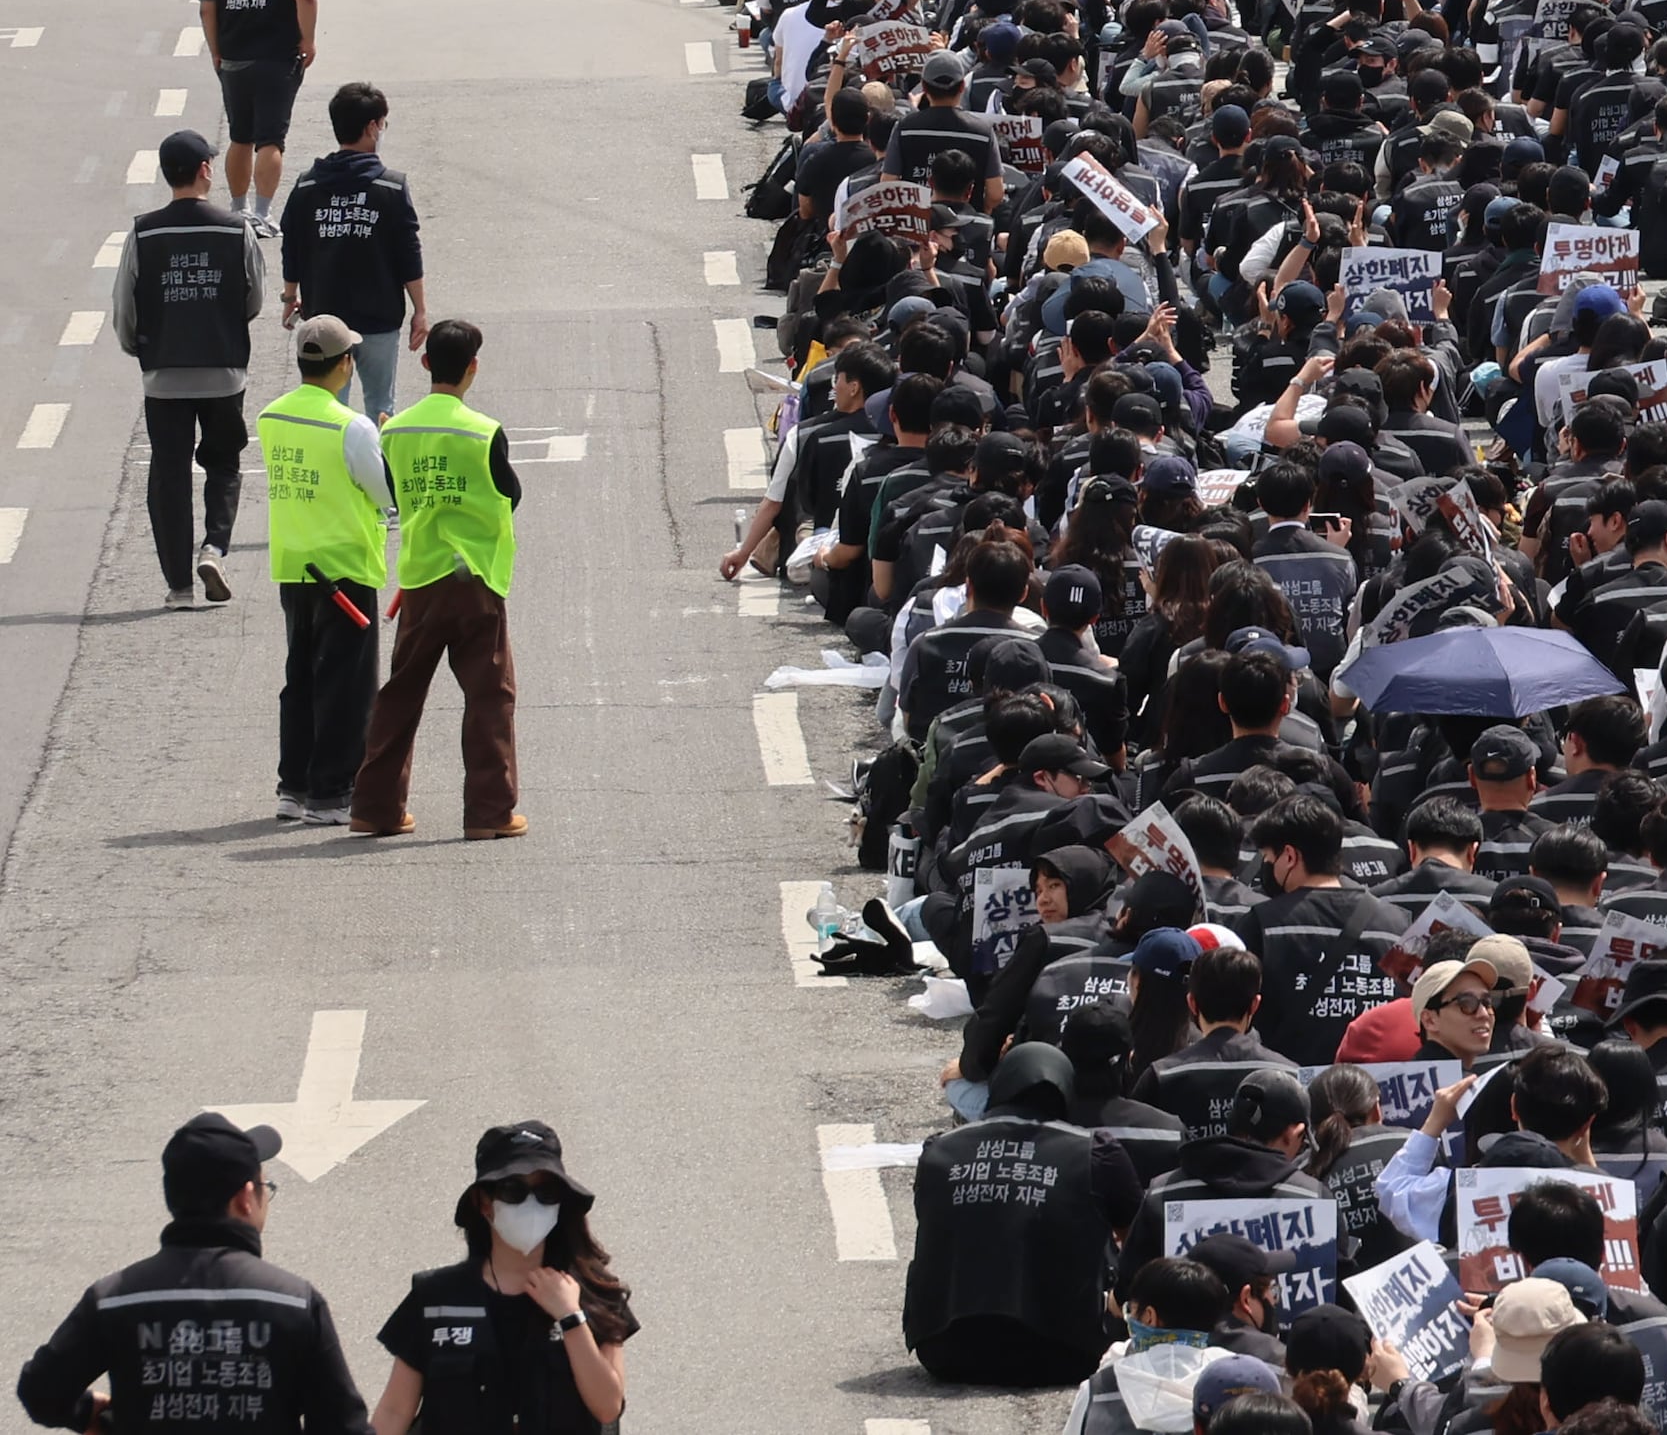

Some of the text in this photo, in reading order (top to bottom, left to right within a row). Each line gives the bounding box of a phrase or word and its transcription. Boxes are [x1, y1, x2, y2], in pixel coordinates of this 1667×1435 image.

[863, 25, 922, 52] 투명하게
[848, 185, 920, 215] 투명하게
[1074, 168, 1148, 224] 투명하게
[315, 206, 379, 223] 초기업 노동조합
[856, 215, 928, 234] 바꾸고!!!
[318, 223, 372, 238] 삼성전자 지부
[1553, 234, 1631, 261] 투명하게
[170, 252, 208, 267] 삼성그룹
[1344, 254, 1430, 285] 상한폐지
[187, 270, 222, 284] 노동조합
[412, 456, 448, 471] 삼성그룹
[402, 477, 427, 493] 초기업
[1281, 580, 1322, 597] 삼성그룹
[969, 842, 1002, 866] 삼성그룹
[1342, 977, 1396, 996] 노동조합
[976, 1140, 1036, 1160] 삼성그룹
[948, 1161, 1058, 1186] 초기업 노동조합
[952, 1185, 1047, 1207] 삼성전자 지부
[1365, 1254, 1433, 1336] 상한폐지
[169, 1326, 243, 1354] 삼성그룹
[432, 1326, 473, 1346] 투쟁
[142, 1361, 272, 1388] 초기업 노동조합
[149, 1394, 263, 1421] 삼성전자 지부
